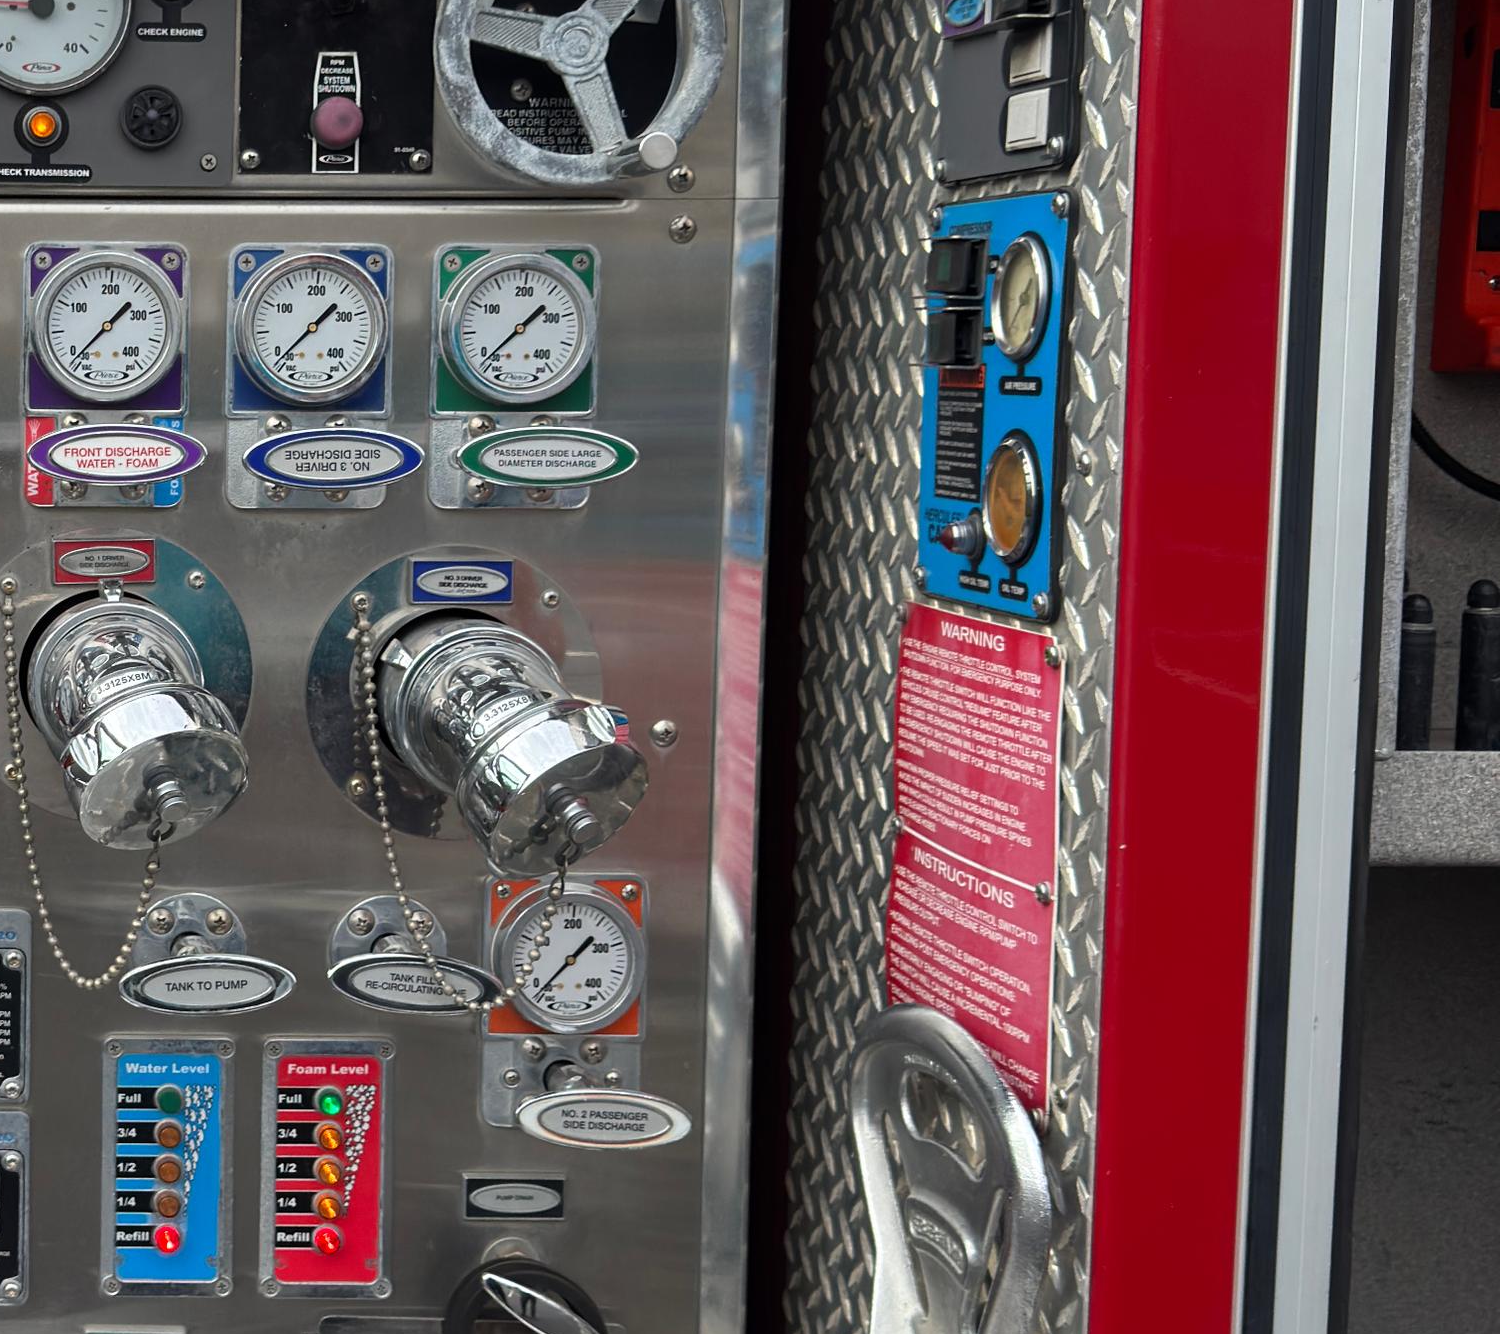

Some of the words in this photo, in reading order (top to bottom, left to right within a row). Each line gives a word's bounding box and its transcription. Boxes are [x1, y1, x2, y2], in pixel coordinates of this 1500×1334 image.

[138, 27, 165, 37] CHECK
[168, 28, 204, 37] ENGINE
[63, 43, 78, 53] 40
[318, 85, 355, 93] SHUTDOWN
[24, 168, 89, 178] TRANSMISSION
[123, 347, 139, 357] 400
[64, 448, 104, 457] FRONT
[106, 448, 171, 457] DISCHARGE
[285, 450, 351, 459] DISCHARGE
[354, 449, 380, 458] SIDE
[494, 449, 546, 457] PASSENGER
[549, 449, 569, 457] SIDE
[571, 450, 601, 458] LARGE
[77, 458, 115, 468] WATER
[125, 458, 158, 467] FOAM
[296, 462, 337, 471] DRIVER
[340, 462, 347, 471] 3
[350, 462, 370, 471] NO.
[498, 459, 543, 467] DIAMETER
[545, 460, 597, 468] DISCHARGE
[940, 620, 1006, 651] WARNING
[913, 848, 1014, 908] INSTRUCTIONS
[390, 973, 414, 983] TANK
[585, 978, 601, 987] 400
[165, 982, 194, 991] TANK
[197, 981, 212, 990] TO
[215, 980, 247, 990] PUMP
[366, 981, 444, 995] RE-CIRCULATING
[126, 1063, 167, 1073] Water
[172, 1063, 209, 1073] Level
[288, 1064, 326, 1074] Foam
[331, 1064, 368, 1074] Level
[118, 1093, 141, 1103] Full
[279, 1094, 302, 1103] Full
[562, 1110, 578, 1118] NO.
[582, 1110, 587, 1118] 2
[590, 1111, 648, 1120] PASSENGER
[563, 1121, 584, 1129] SIDE
[588, 1122, 645, 1131] DISCHARGE
[118, 1128, 136, 1138] 3/4
[278, 1129, 297, 1138] 3/4
[118, 1163, 136, 1172] 1/2
[278, 1163, 297, 1173] 1/2
[117, 1197, 136, 1206] 1/4
[278, 1198, 296, 1207] 1/4
[116, 1231, 149, 1242] Refill
[277, 1232, 309, 1242] Refill
